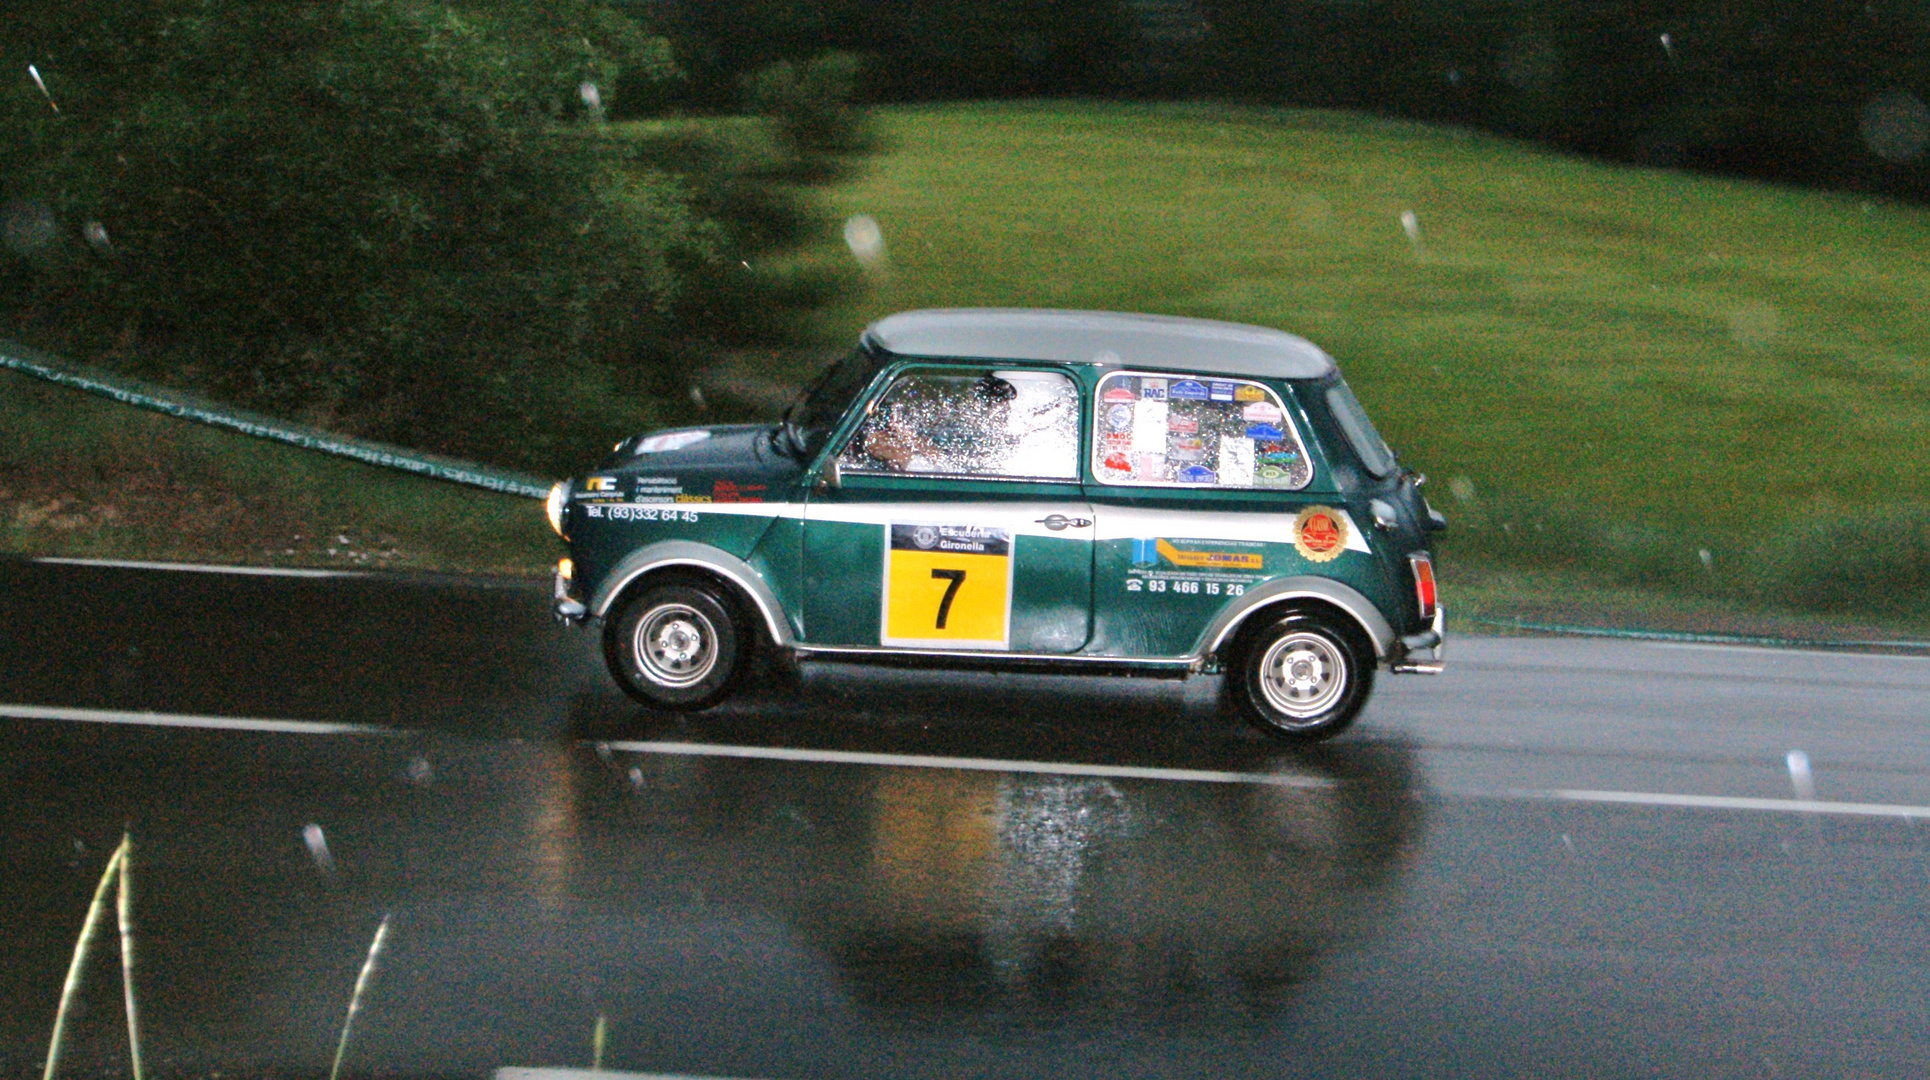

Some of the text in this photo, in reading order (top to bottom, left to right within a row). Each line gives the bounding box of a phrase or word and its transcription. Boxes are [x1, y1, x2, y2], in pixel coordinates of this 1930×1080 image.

[1143, 388, 1165, 399] RAC
[586, 505, 604, 517] Tel.
[662, 509, 677, 520] 64
[682, 511, 698, 522] 45
[940, 540, 985, 551] Gironella
[1148, 580, 1244, 596] 93 466 15 26
[931, 568, 966, 630] 7
